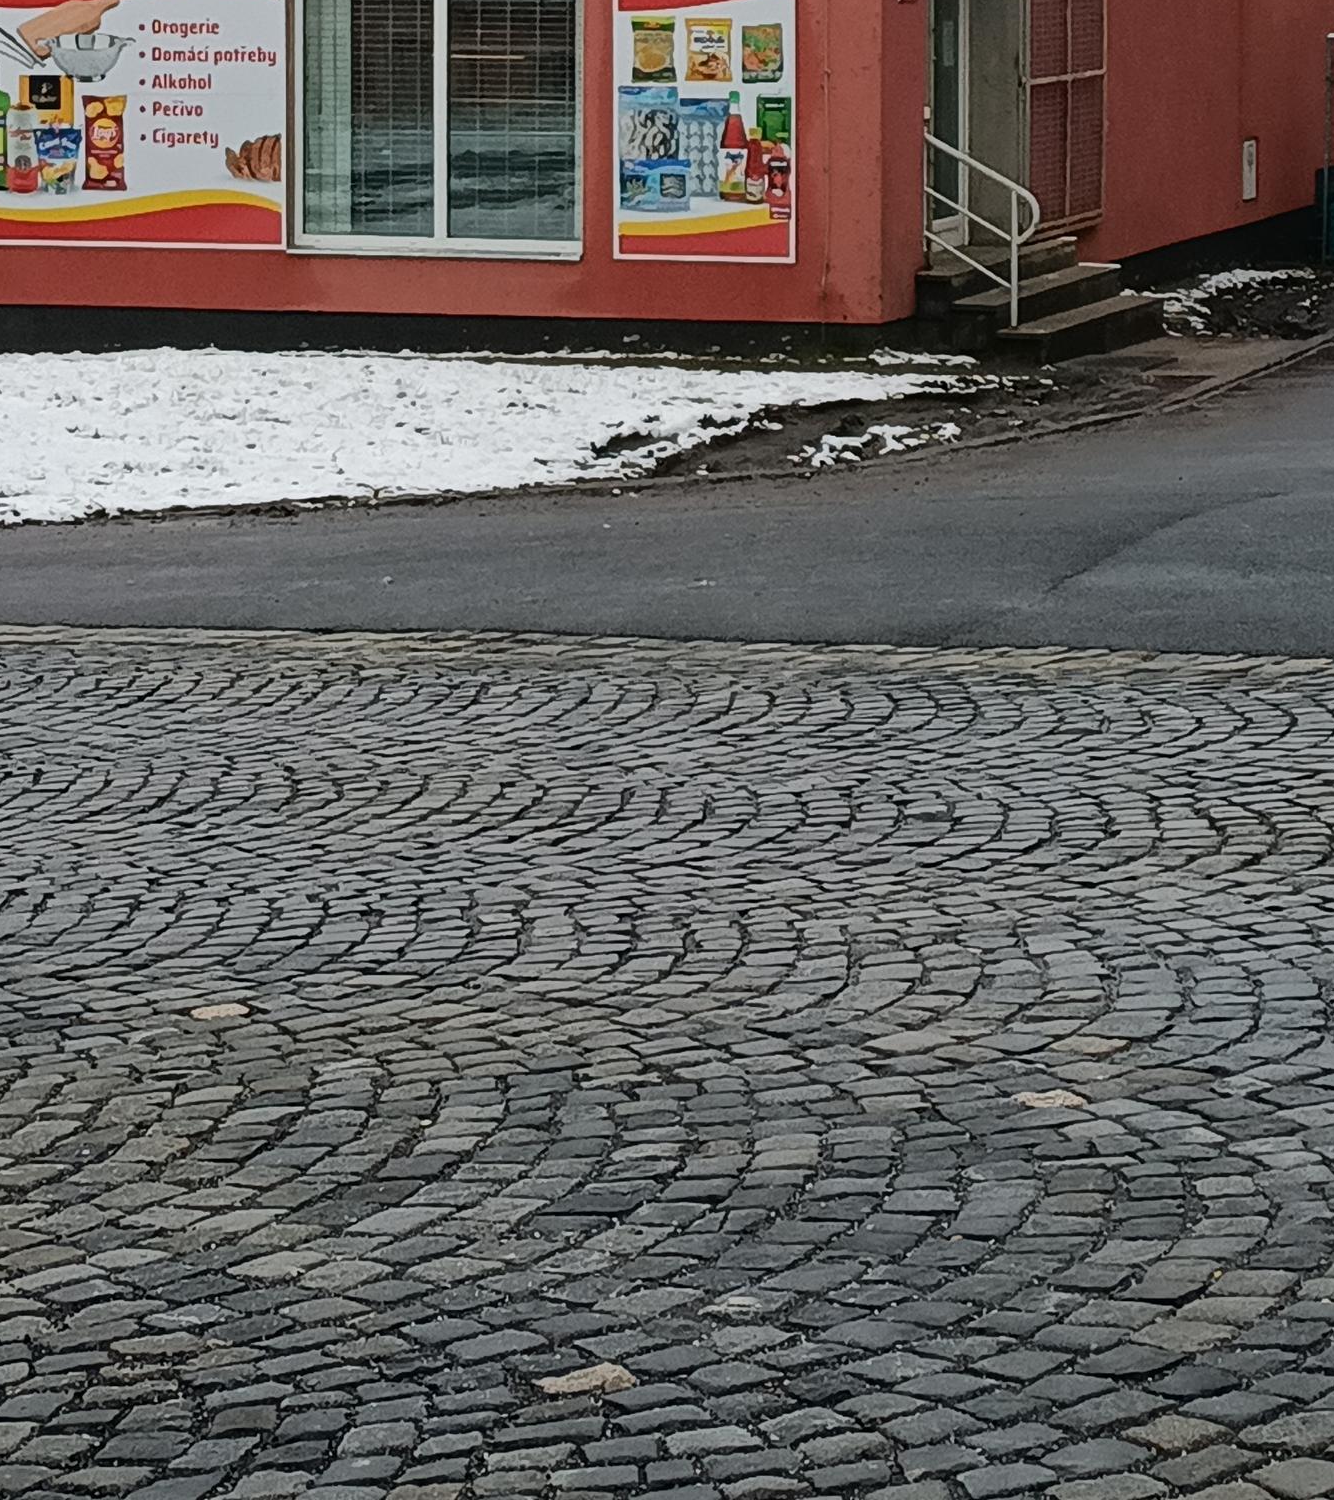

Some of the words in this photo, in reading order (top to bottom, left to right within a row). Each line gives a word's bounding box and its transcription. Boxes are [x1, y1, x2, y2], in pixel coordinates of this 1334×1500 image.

[151, 18, 220, 38] Drogerie
[151, 46, 209, 62] Domácí
[213, 46, 277, 67] potřeby
[151, 73, 212, 90] Alkohol
[152, 100, 203, 117] Pečivo
[152, 128, 219, 149] Cigarety
